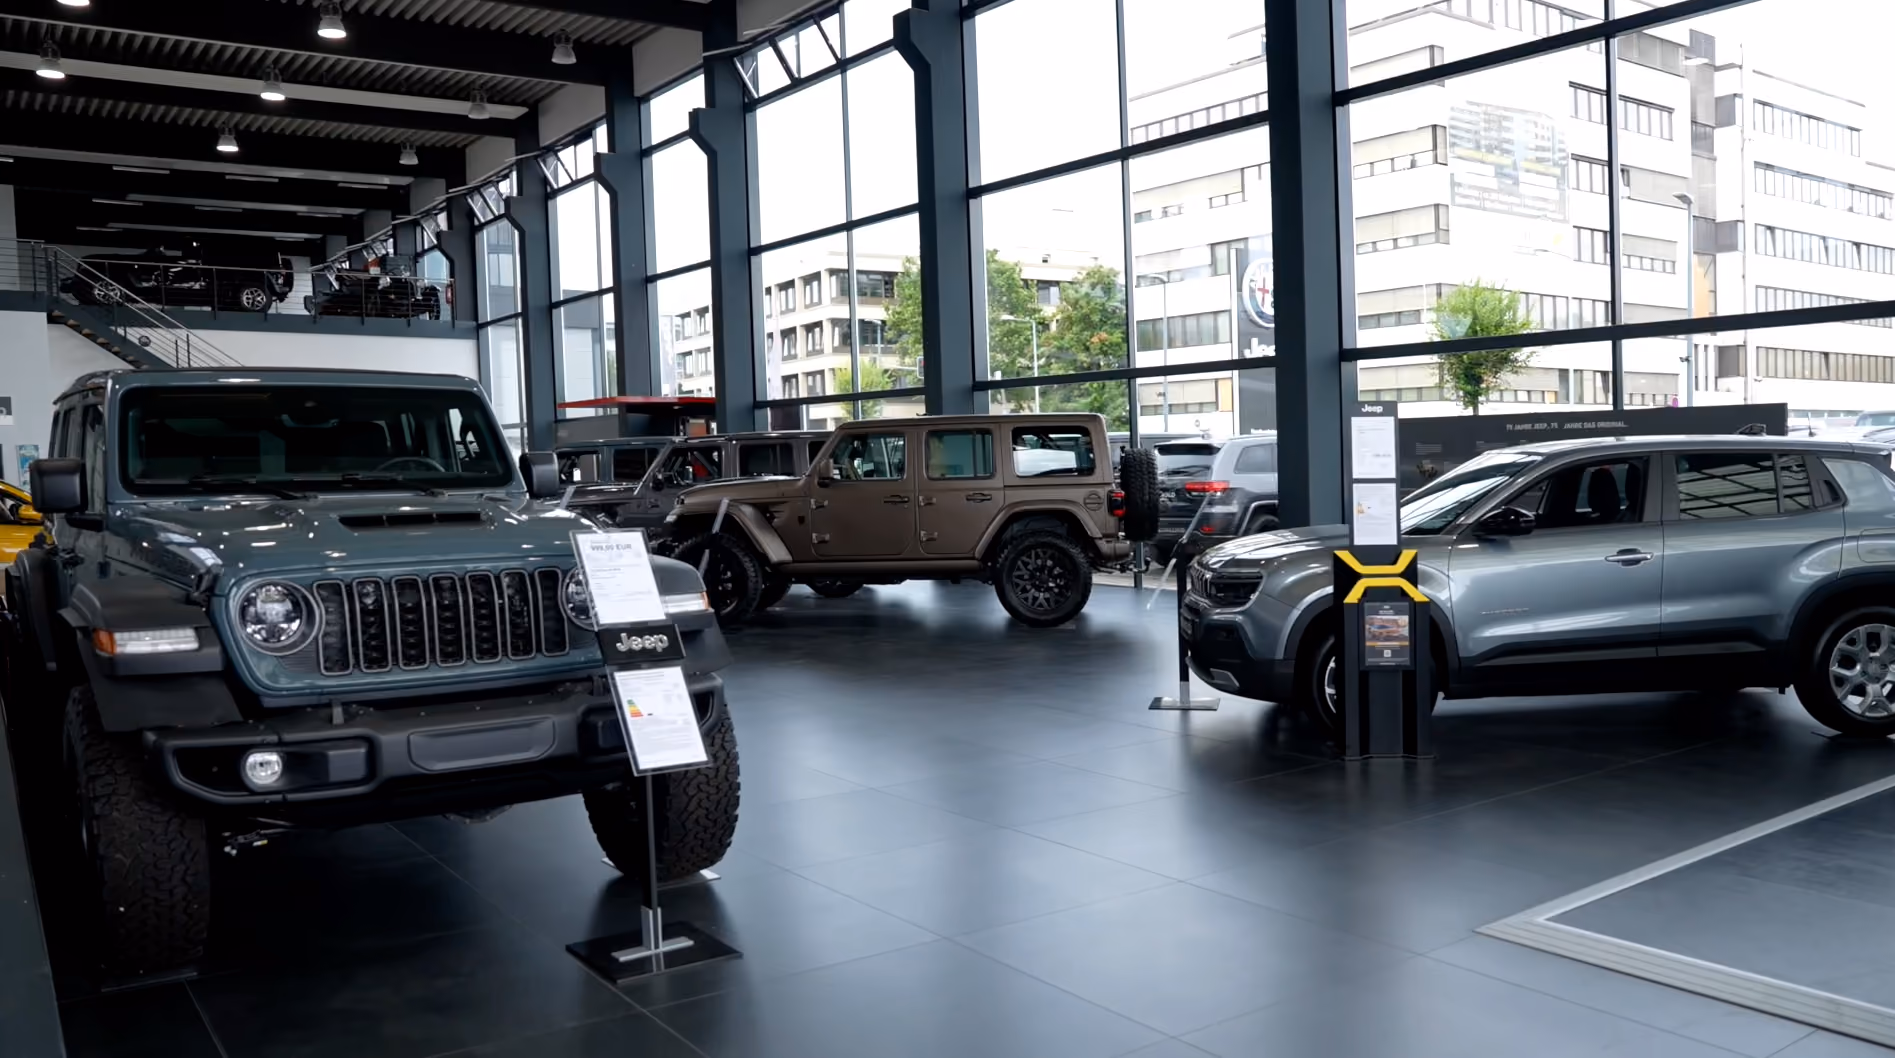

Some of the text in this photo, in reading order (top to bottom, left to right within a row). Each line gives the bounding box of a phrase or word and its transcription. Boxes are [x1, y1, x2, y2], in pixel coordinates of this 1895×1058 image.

[1361, 403, 1384, 413] Jeep
[616, 543, 633, 551] EUR
[616, 632, 669, 653] Jeep
